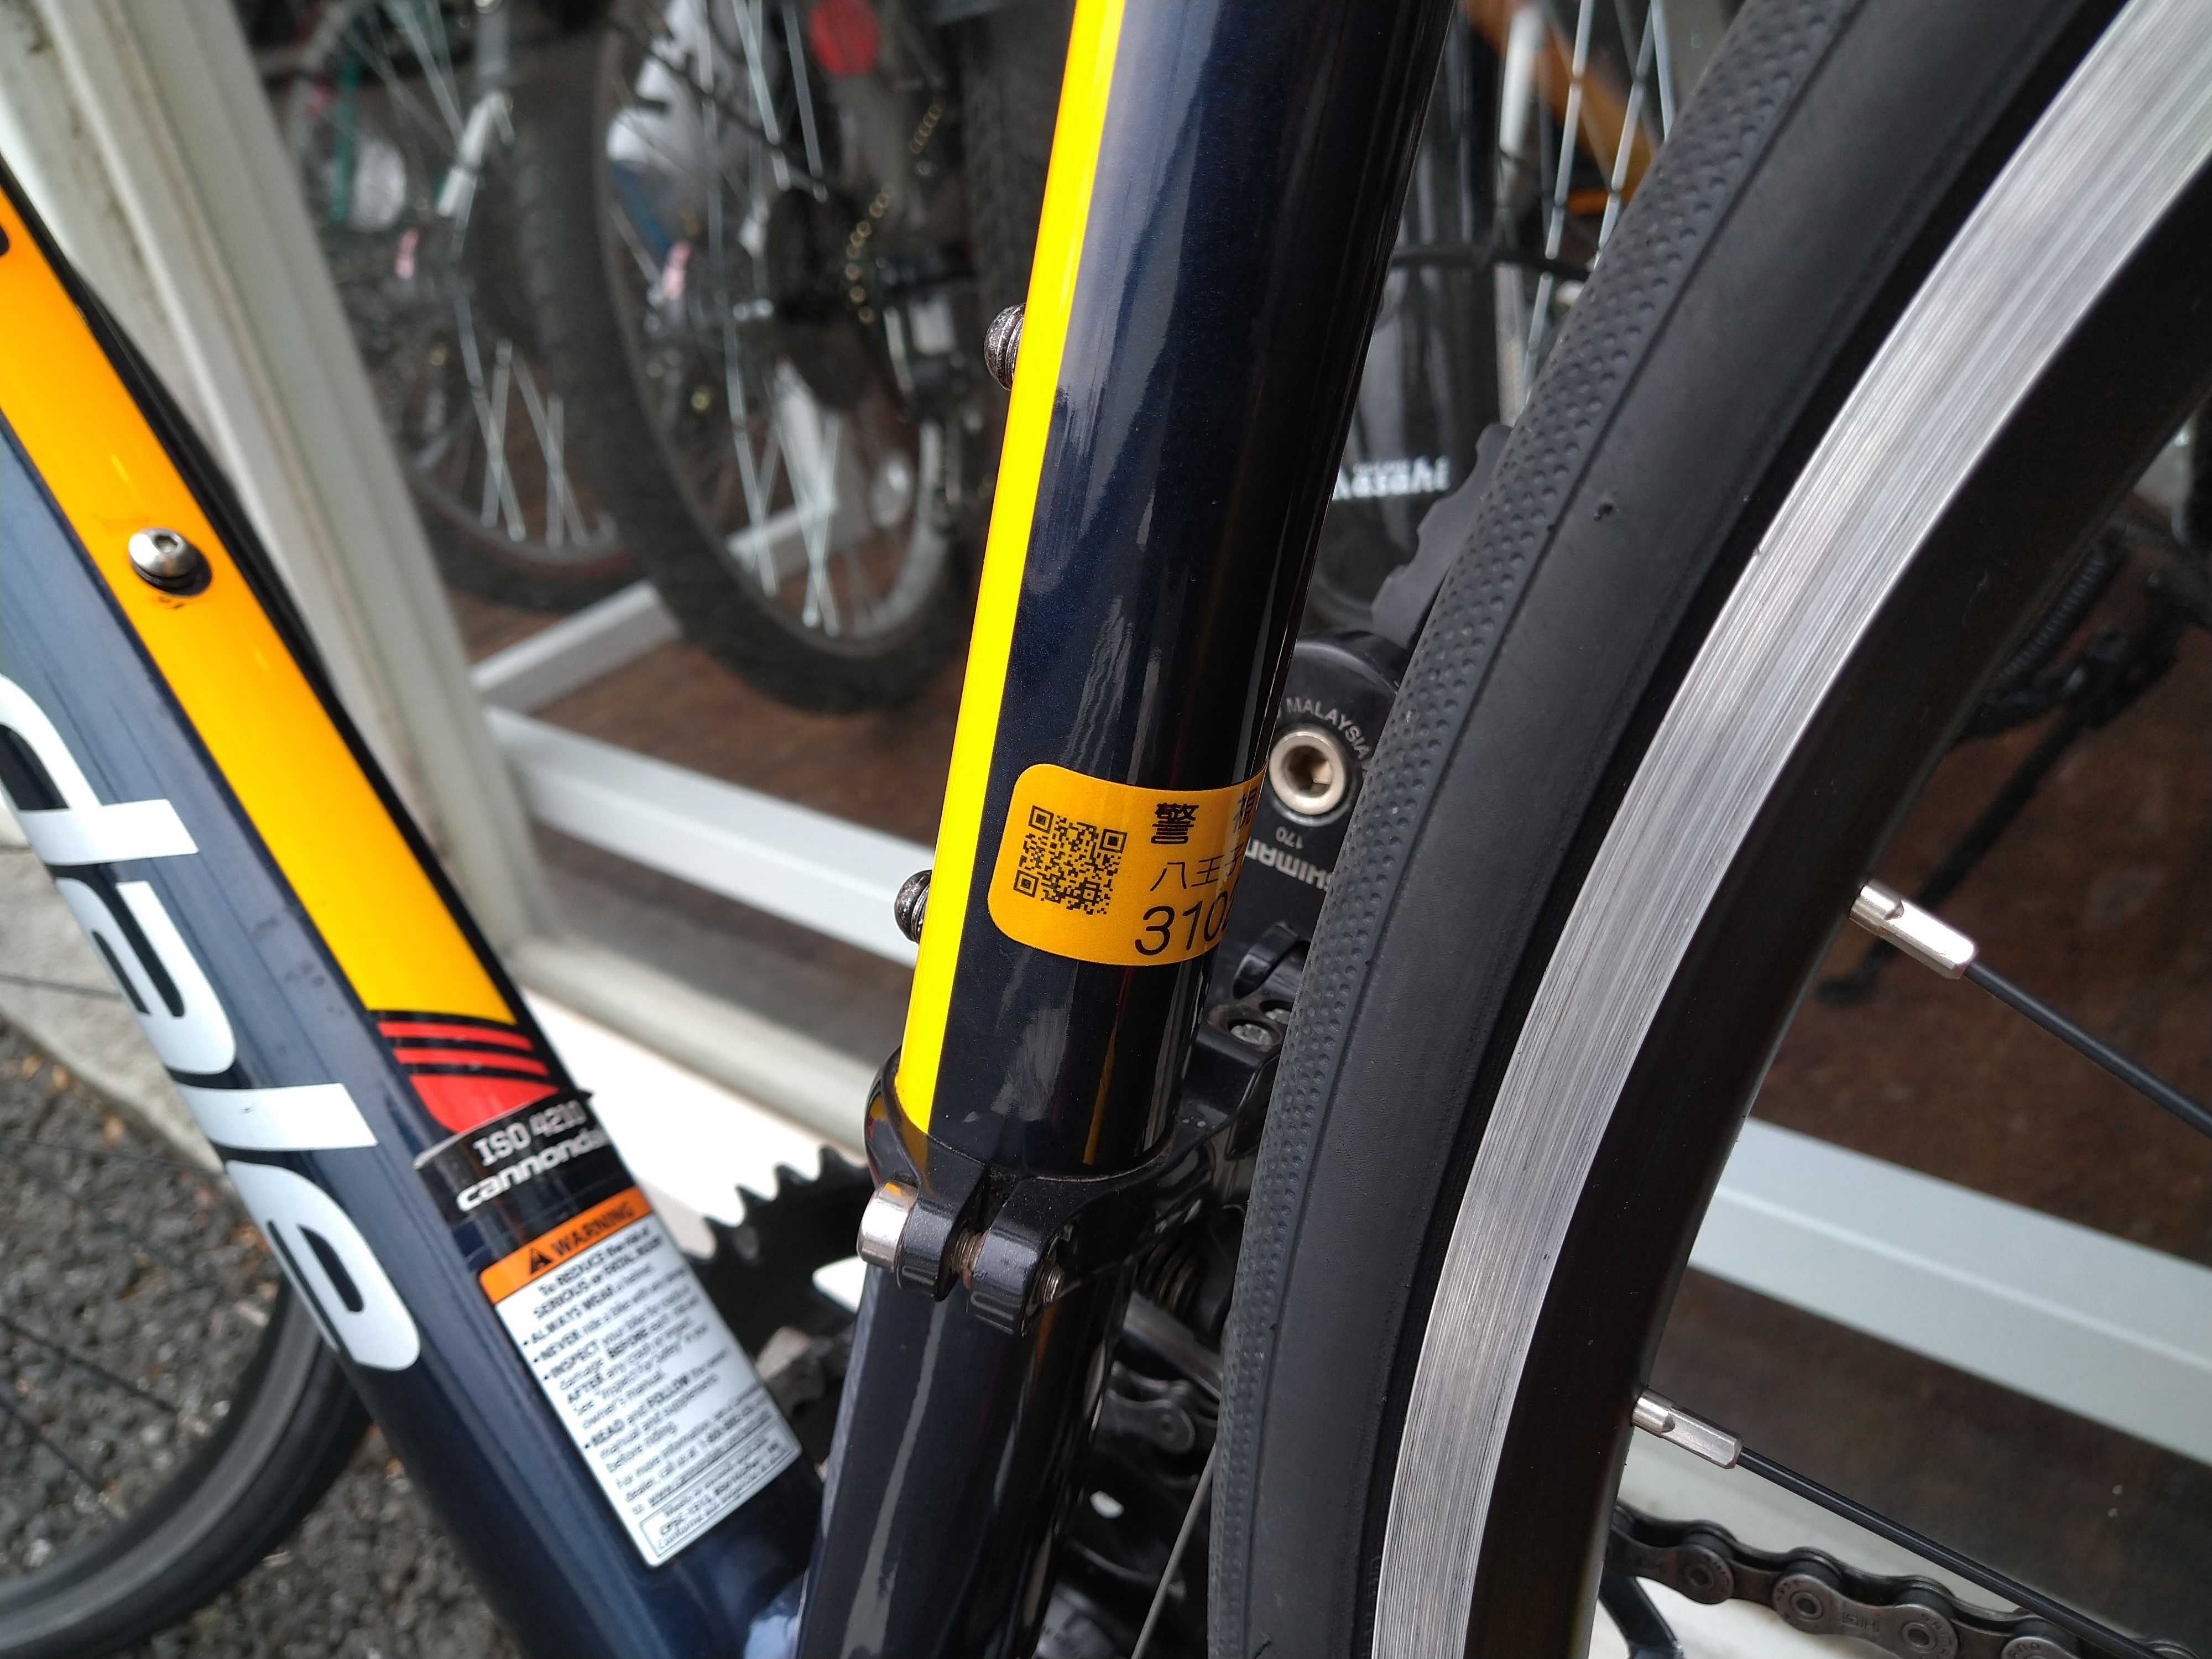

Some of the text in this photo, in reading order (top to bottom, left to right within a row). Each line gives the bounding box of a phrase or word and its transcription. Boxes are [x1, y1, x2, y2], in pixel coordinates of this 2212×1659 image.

[1285, 696, 1371, 761] MALAYSIA
[1275, 826, 1305, 850] 170
[1134, 880, 1238, 956] 310
[473, 1121, 532, 1166] ISO
[551, 1201, 635, 1257] WARNING
